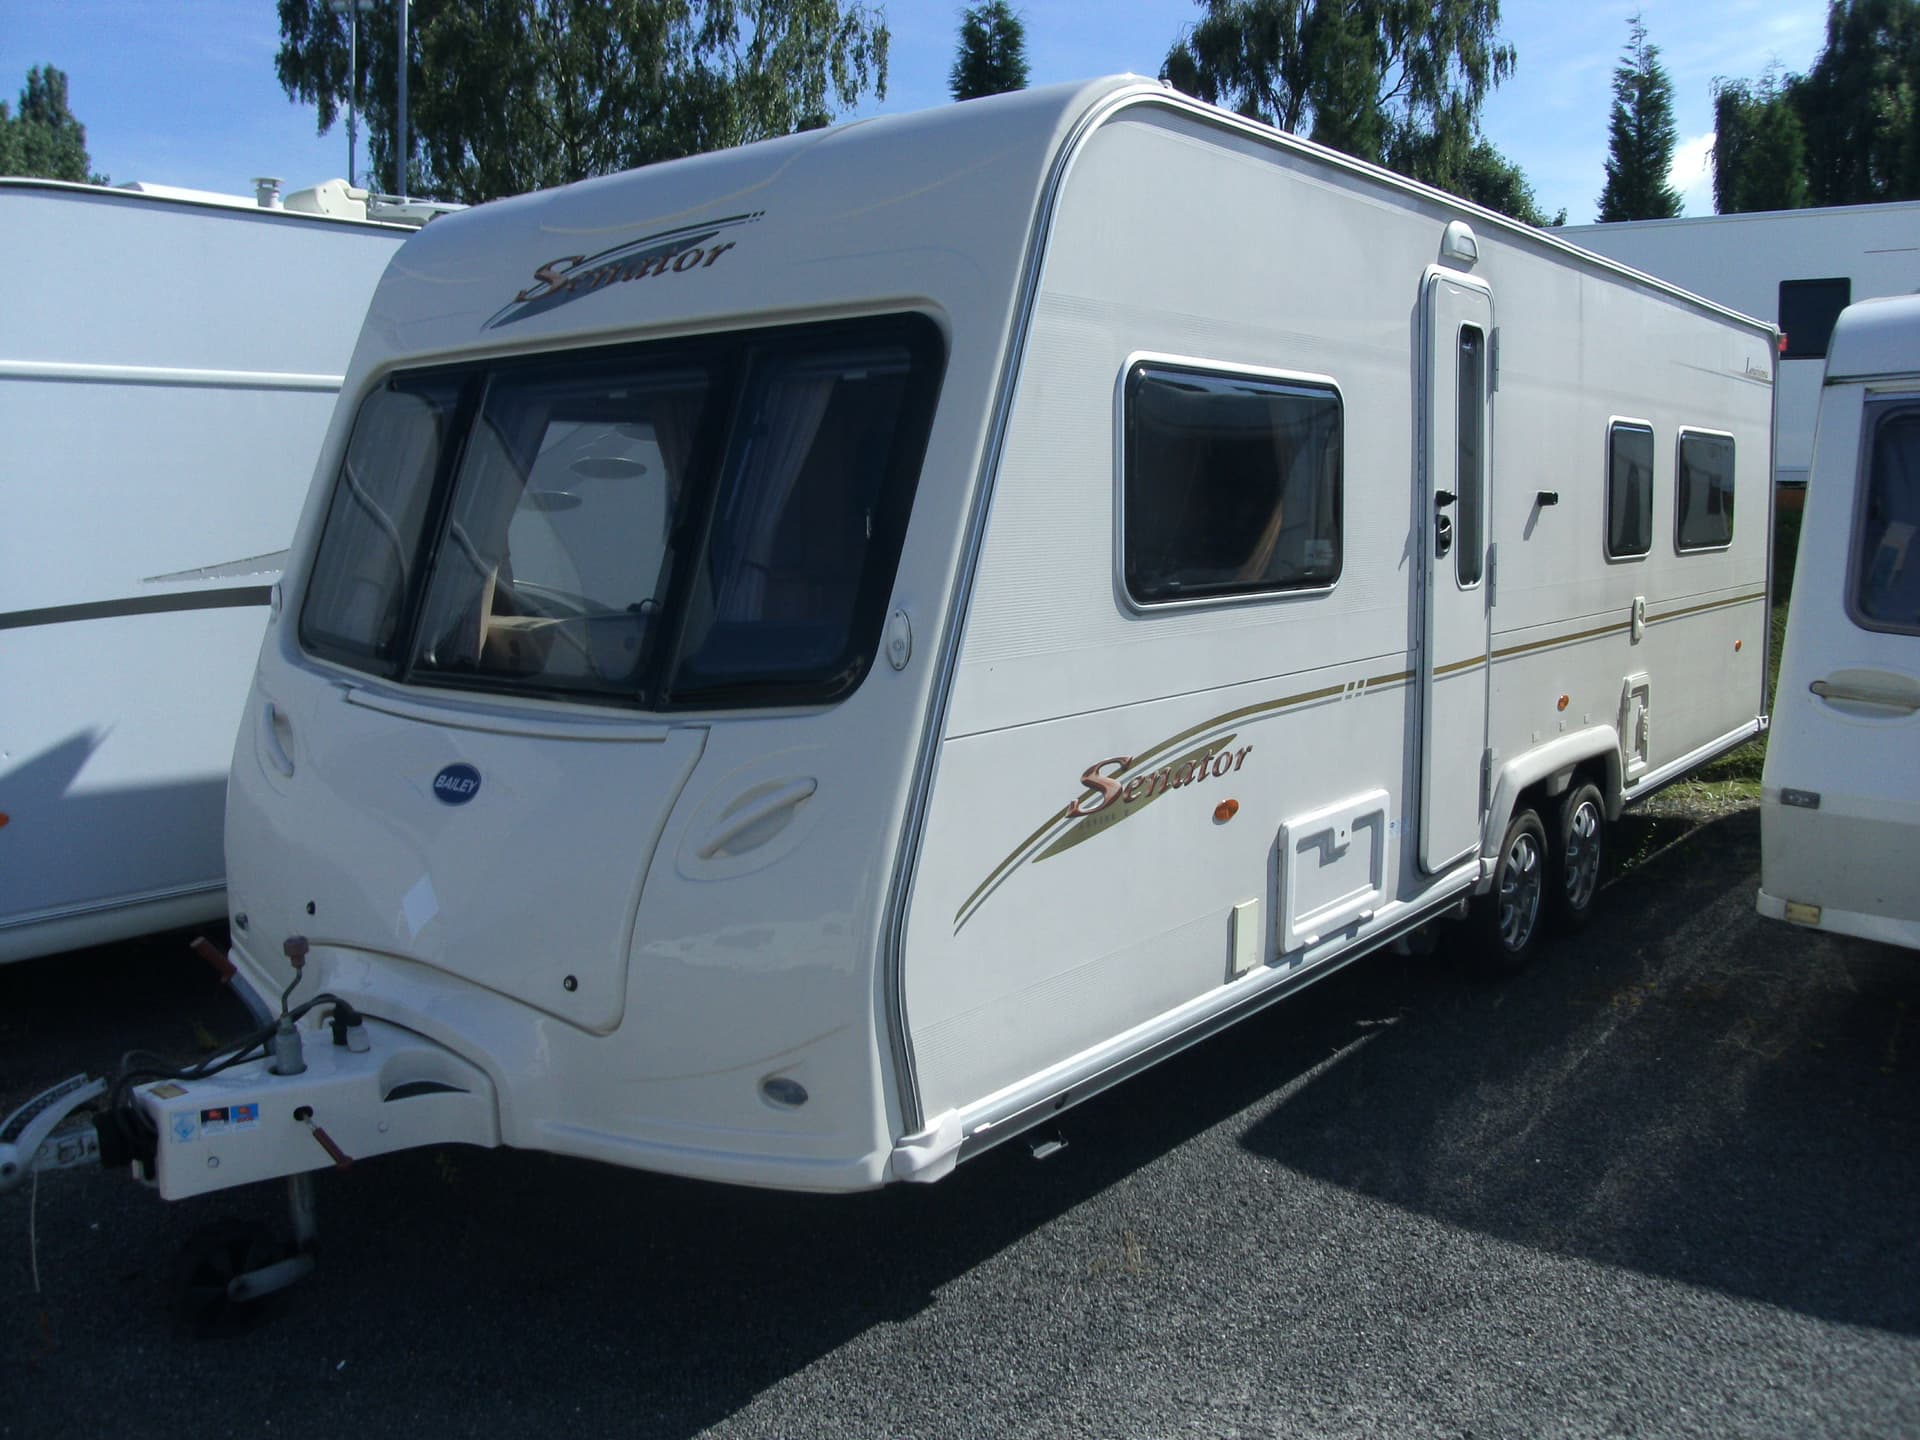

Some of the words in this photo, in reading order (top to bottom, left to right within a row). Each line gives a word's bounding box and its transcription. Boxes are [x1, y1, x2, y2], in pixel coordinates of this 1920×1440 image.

[514, 242, 736, 303] Senator
[434, 775, 478, 792] BAILEY
[1065, 746, 1253, 818] Senator
